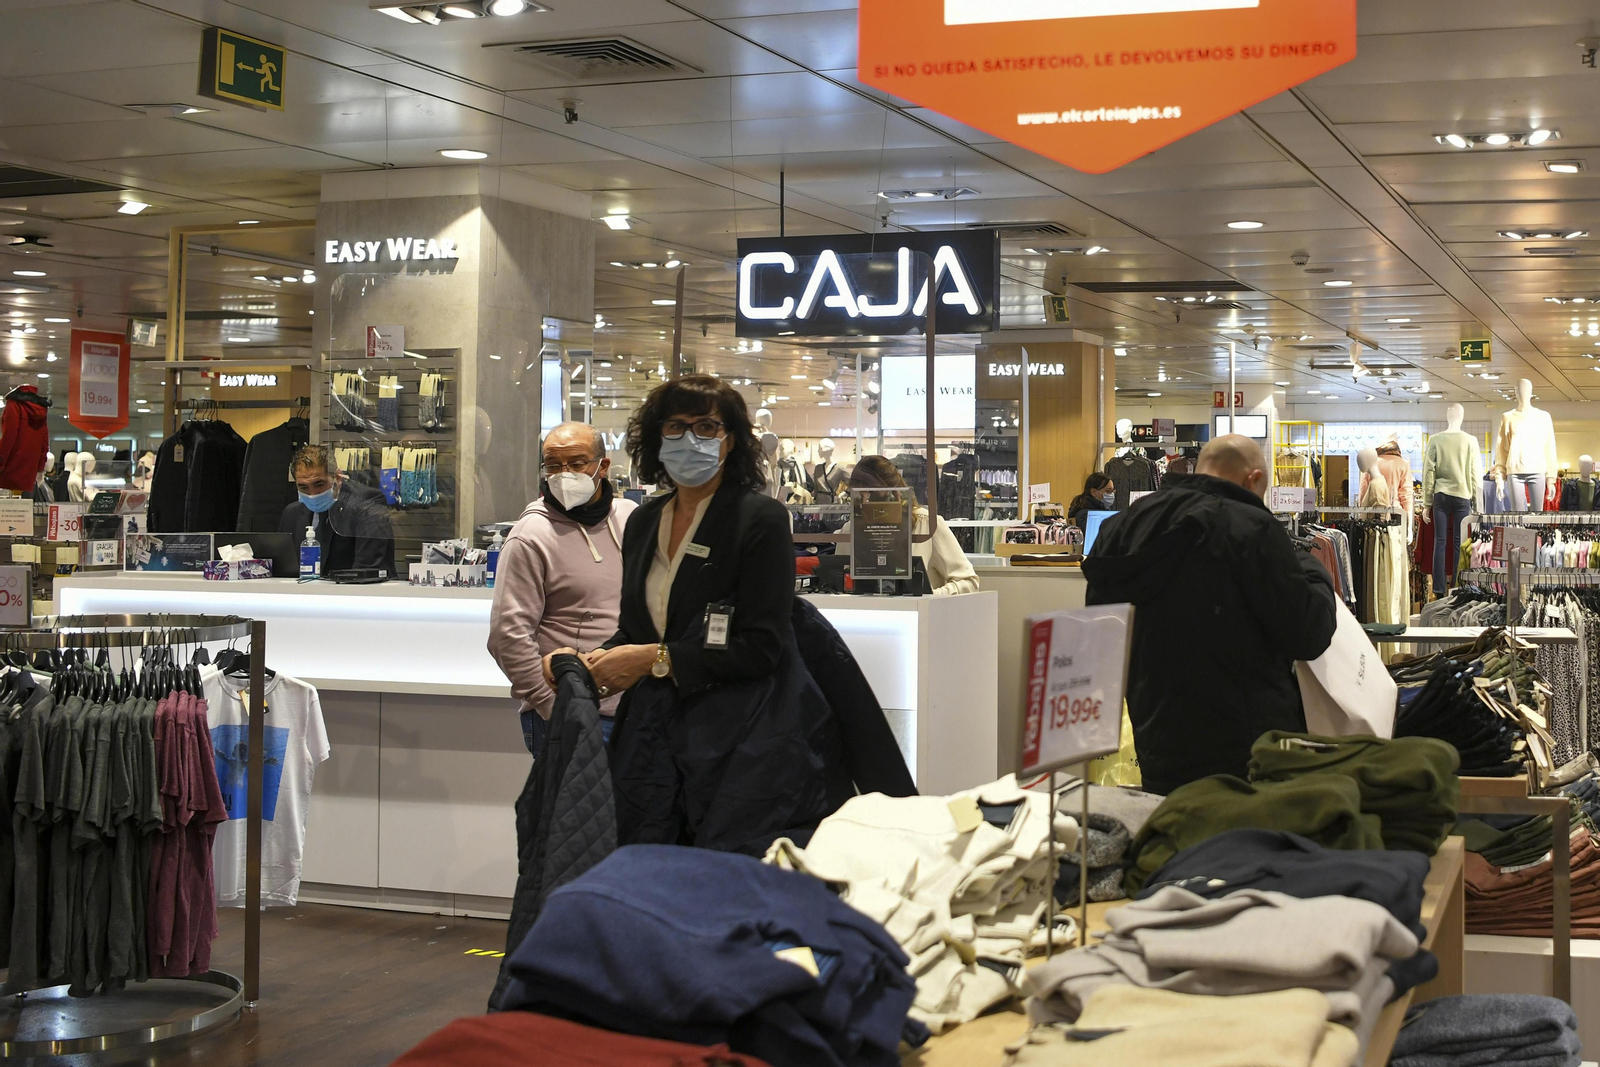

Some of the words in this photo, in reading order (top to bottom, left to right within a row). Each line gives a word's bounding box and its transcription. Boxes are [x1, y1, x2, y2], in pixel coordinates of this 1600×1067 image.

[874, 65, 888, 78] SI
[894, 63, 917, 77] NO
[922, 59, 977, 76] QUEDA
[983, 53, 1090, 73] SATISFECHO,
[1094, 53, 1114, 67] LE
[1120, 47, 1234, 66] DEVOLVEMOS
[1241, 44, 1264, 60] SU
[1269, 41, 1337, 58] DINERO
[1017, 105, 1182, 125] www.elcorteingles.es
[325, 240, 381, 263] EASY
[386, 237, 459, 261] WEAR
[739, 245, 979, 320] CAJA
[89, 364, 117, 376] TODO
[988, 363, 1021, 376] EASY
[1026, 363, 1065, 375] WEAR
[219, 374, 245, 387] EASY
[245, 374, 277, 387] WEAR
[906, 386, 926, 396] EAS
[939, 386, 973, 395] WEAR
[84, 392, 113, 405] 19,99€
[601, 432, 626, 450] LY
[63, 511, 78, 519] TOD
[60, 520, 79, 531] -30
[1509, 533, 1529, 541] TODO
[1505, 542, 1529, 554] 129€
[0, 589, 23, 607] 0%
[1049, 692, 1103, 730] 19,99€
